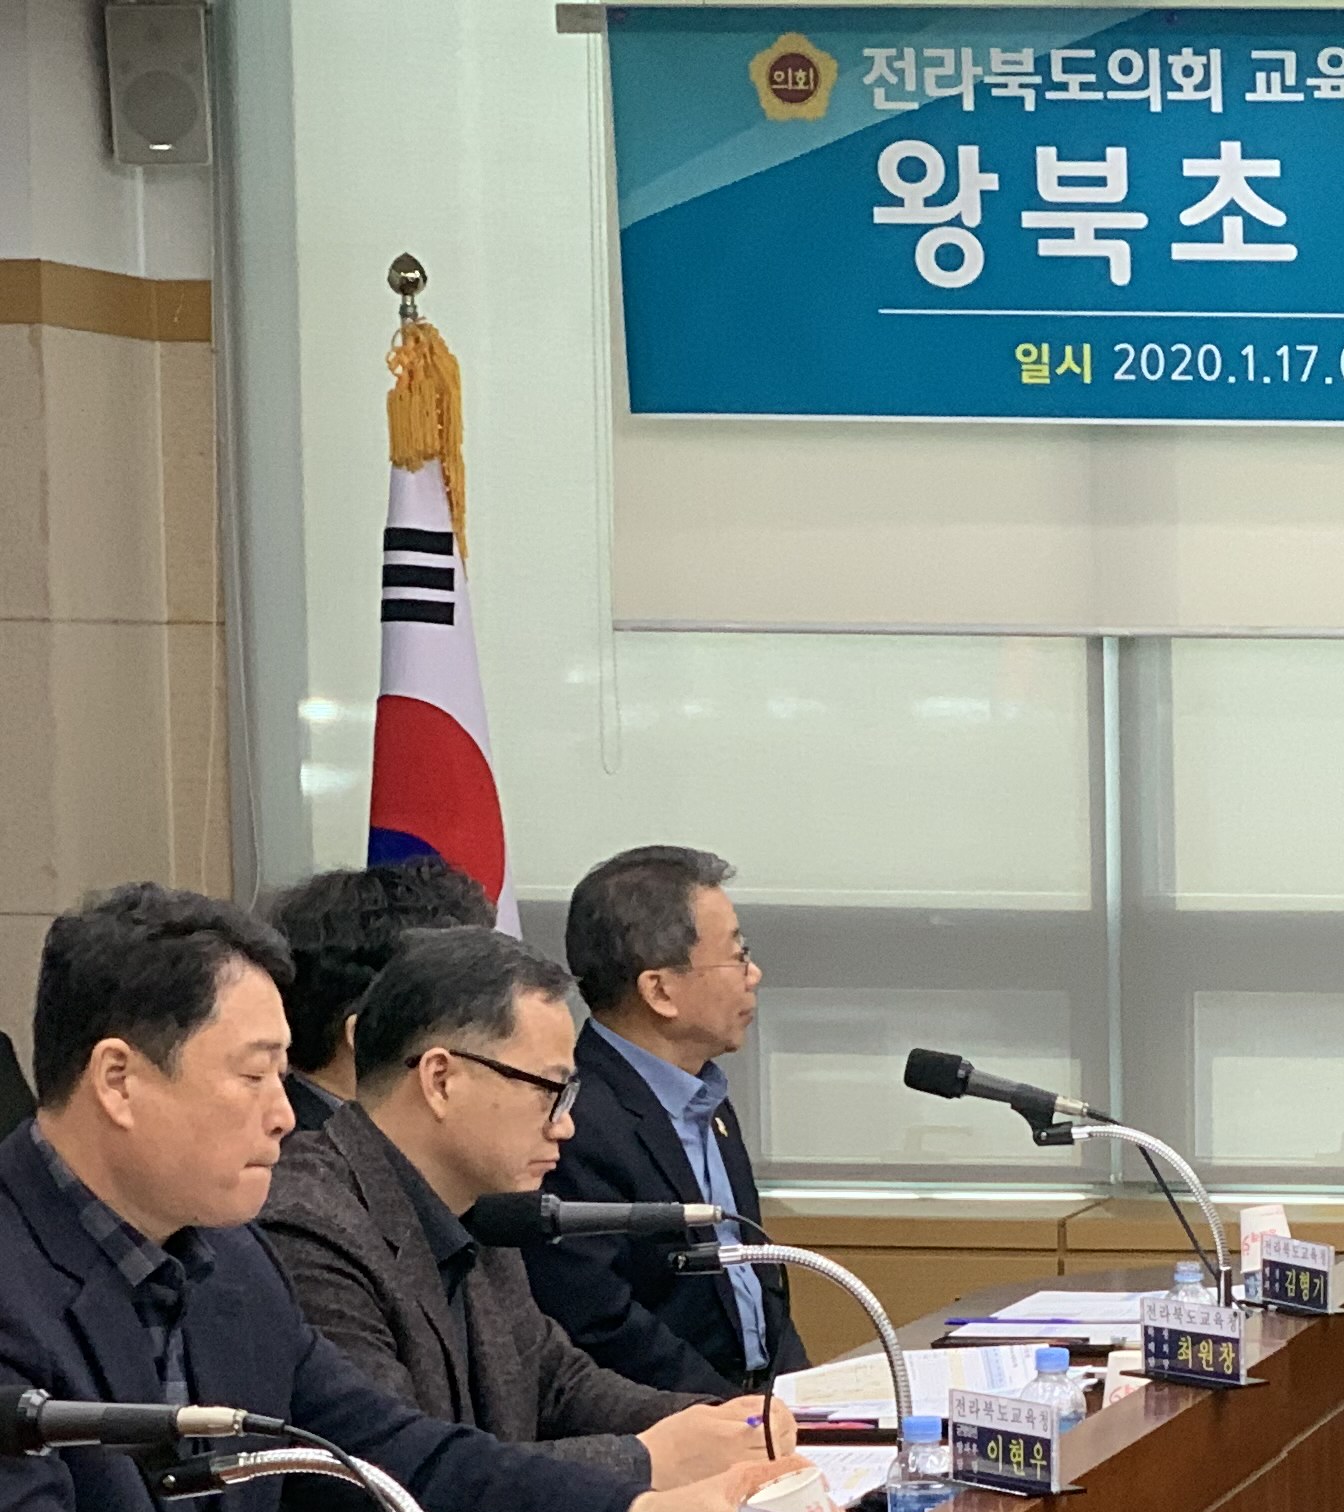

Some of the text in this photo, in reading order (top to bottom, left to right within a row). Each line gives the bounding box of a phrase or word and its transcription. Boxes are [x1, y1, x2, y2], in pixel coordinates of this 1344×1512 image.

[771, 66, 815, 91] 의회
[864, 47, 1222, 114] 전라북도의회
[873, 140, 1297, 288] 왕북초
[1015, 344, 1091, 384] 일시
[1284, 1268, 1325, 1305] 김형기
[1146, 1304, 1237, 1332] 전라북도교육청
[1177, 1335, 1235, 1375] 최원창
[955, 1396, 1048, 1432] 전라북도교육청
[987, 1434, 1047, 1480] 이현우
